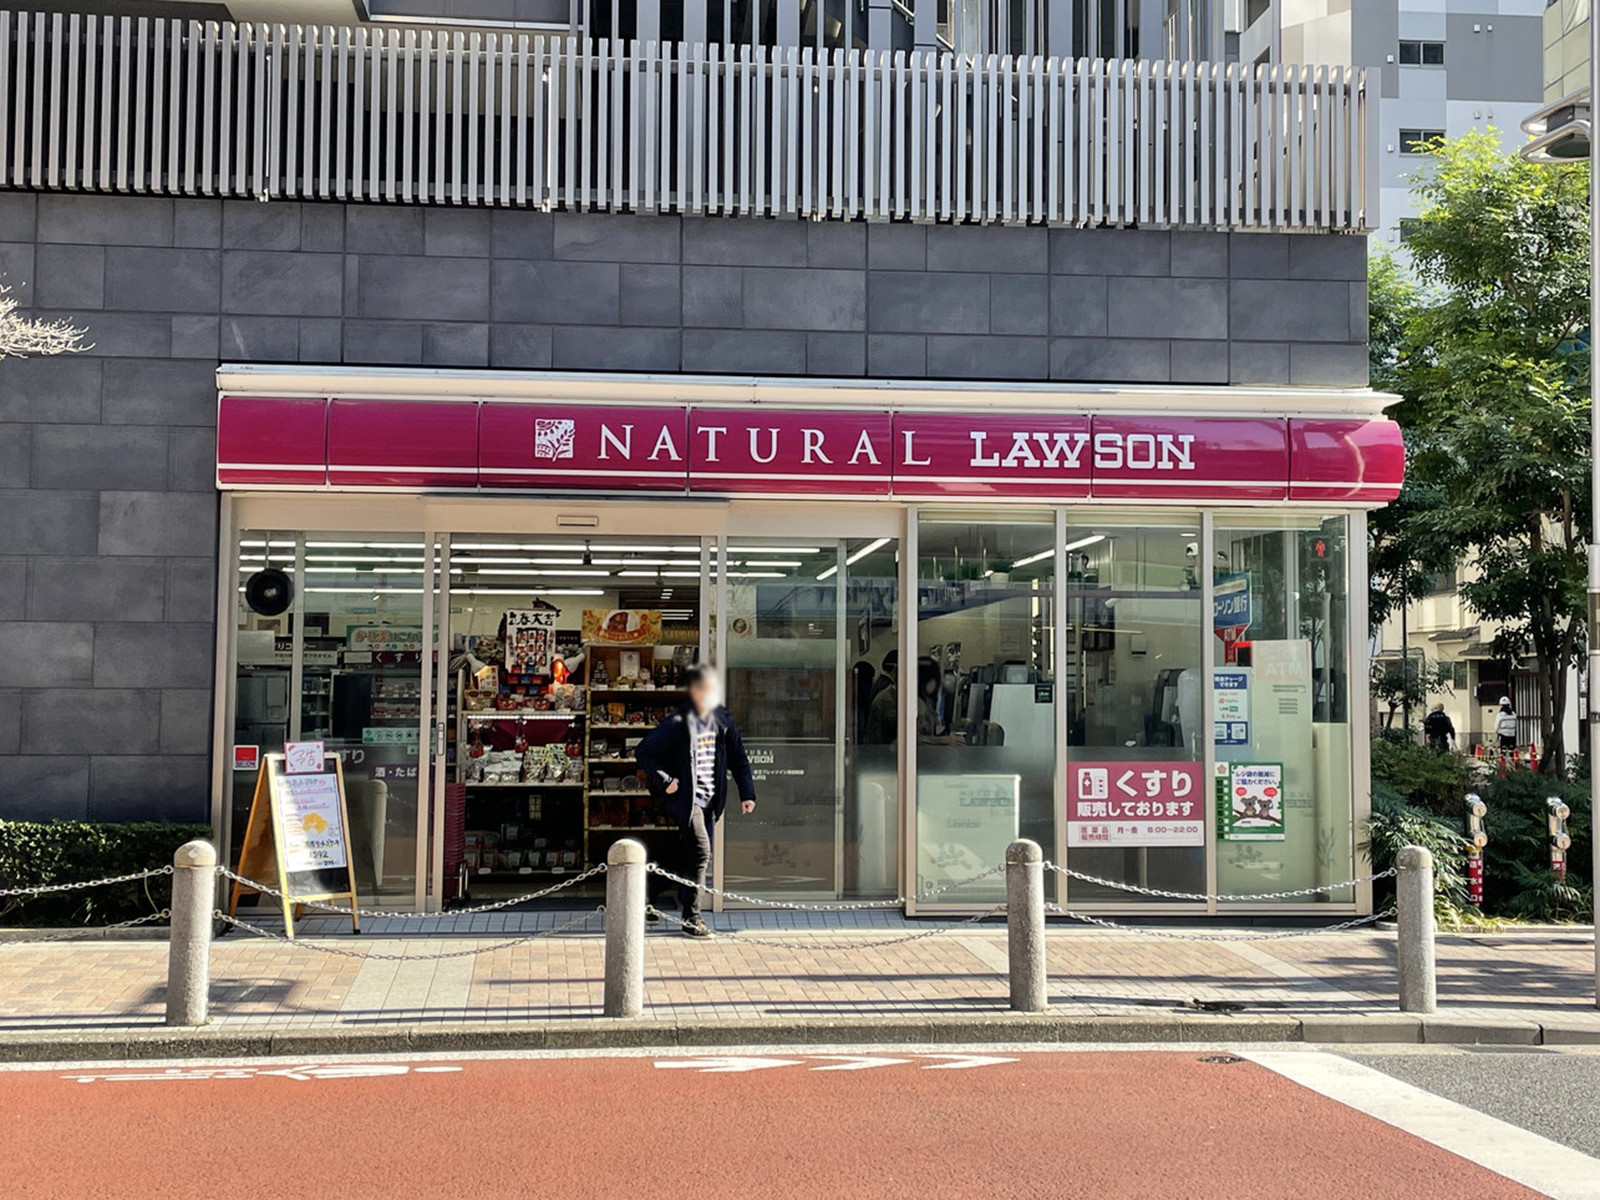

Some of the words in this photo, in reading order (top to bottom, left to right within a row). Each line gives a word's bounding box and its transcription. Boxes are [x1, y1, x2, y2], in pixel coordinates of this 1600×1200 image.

[597, 424, 931, 465] NATURAL
[970, 431, 1195, 470] LAWSON
[1115, 769, 1193, 798] くすり
[1077, 801, 1194, 818] 販売しております
